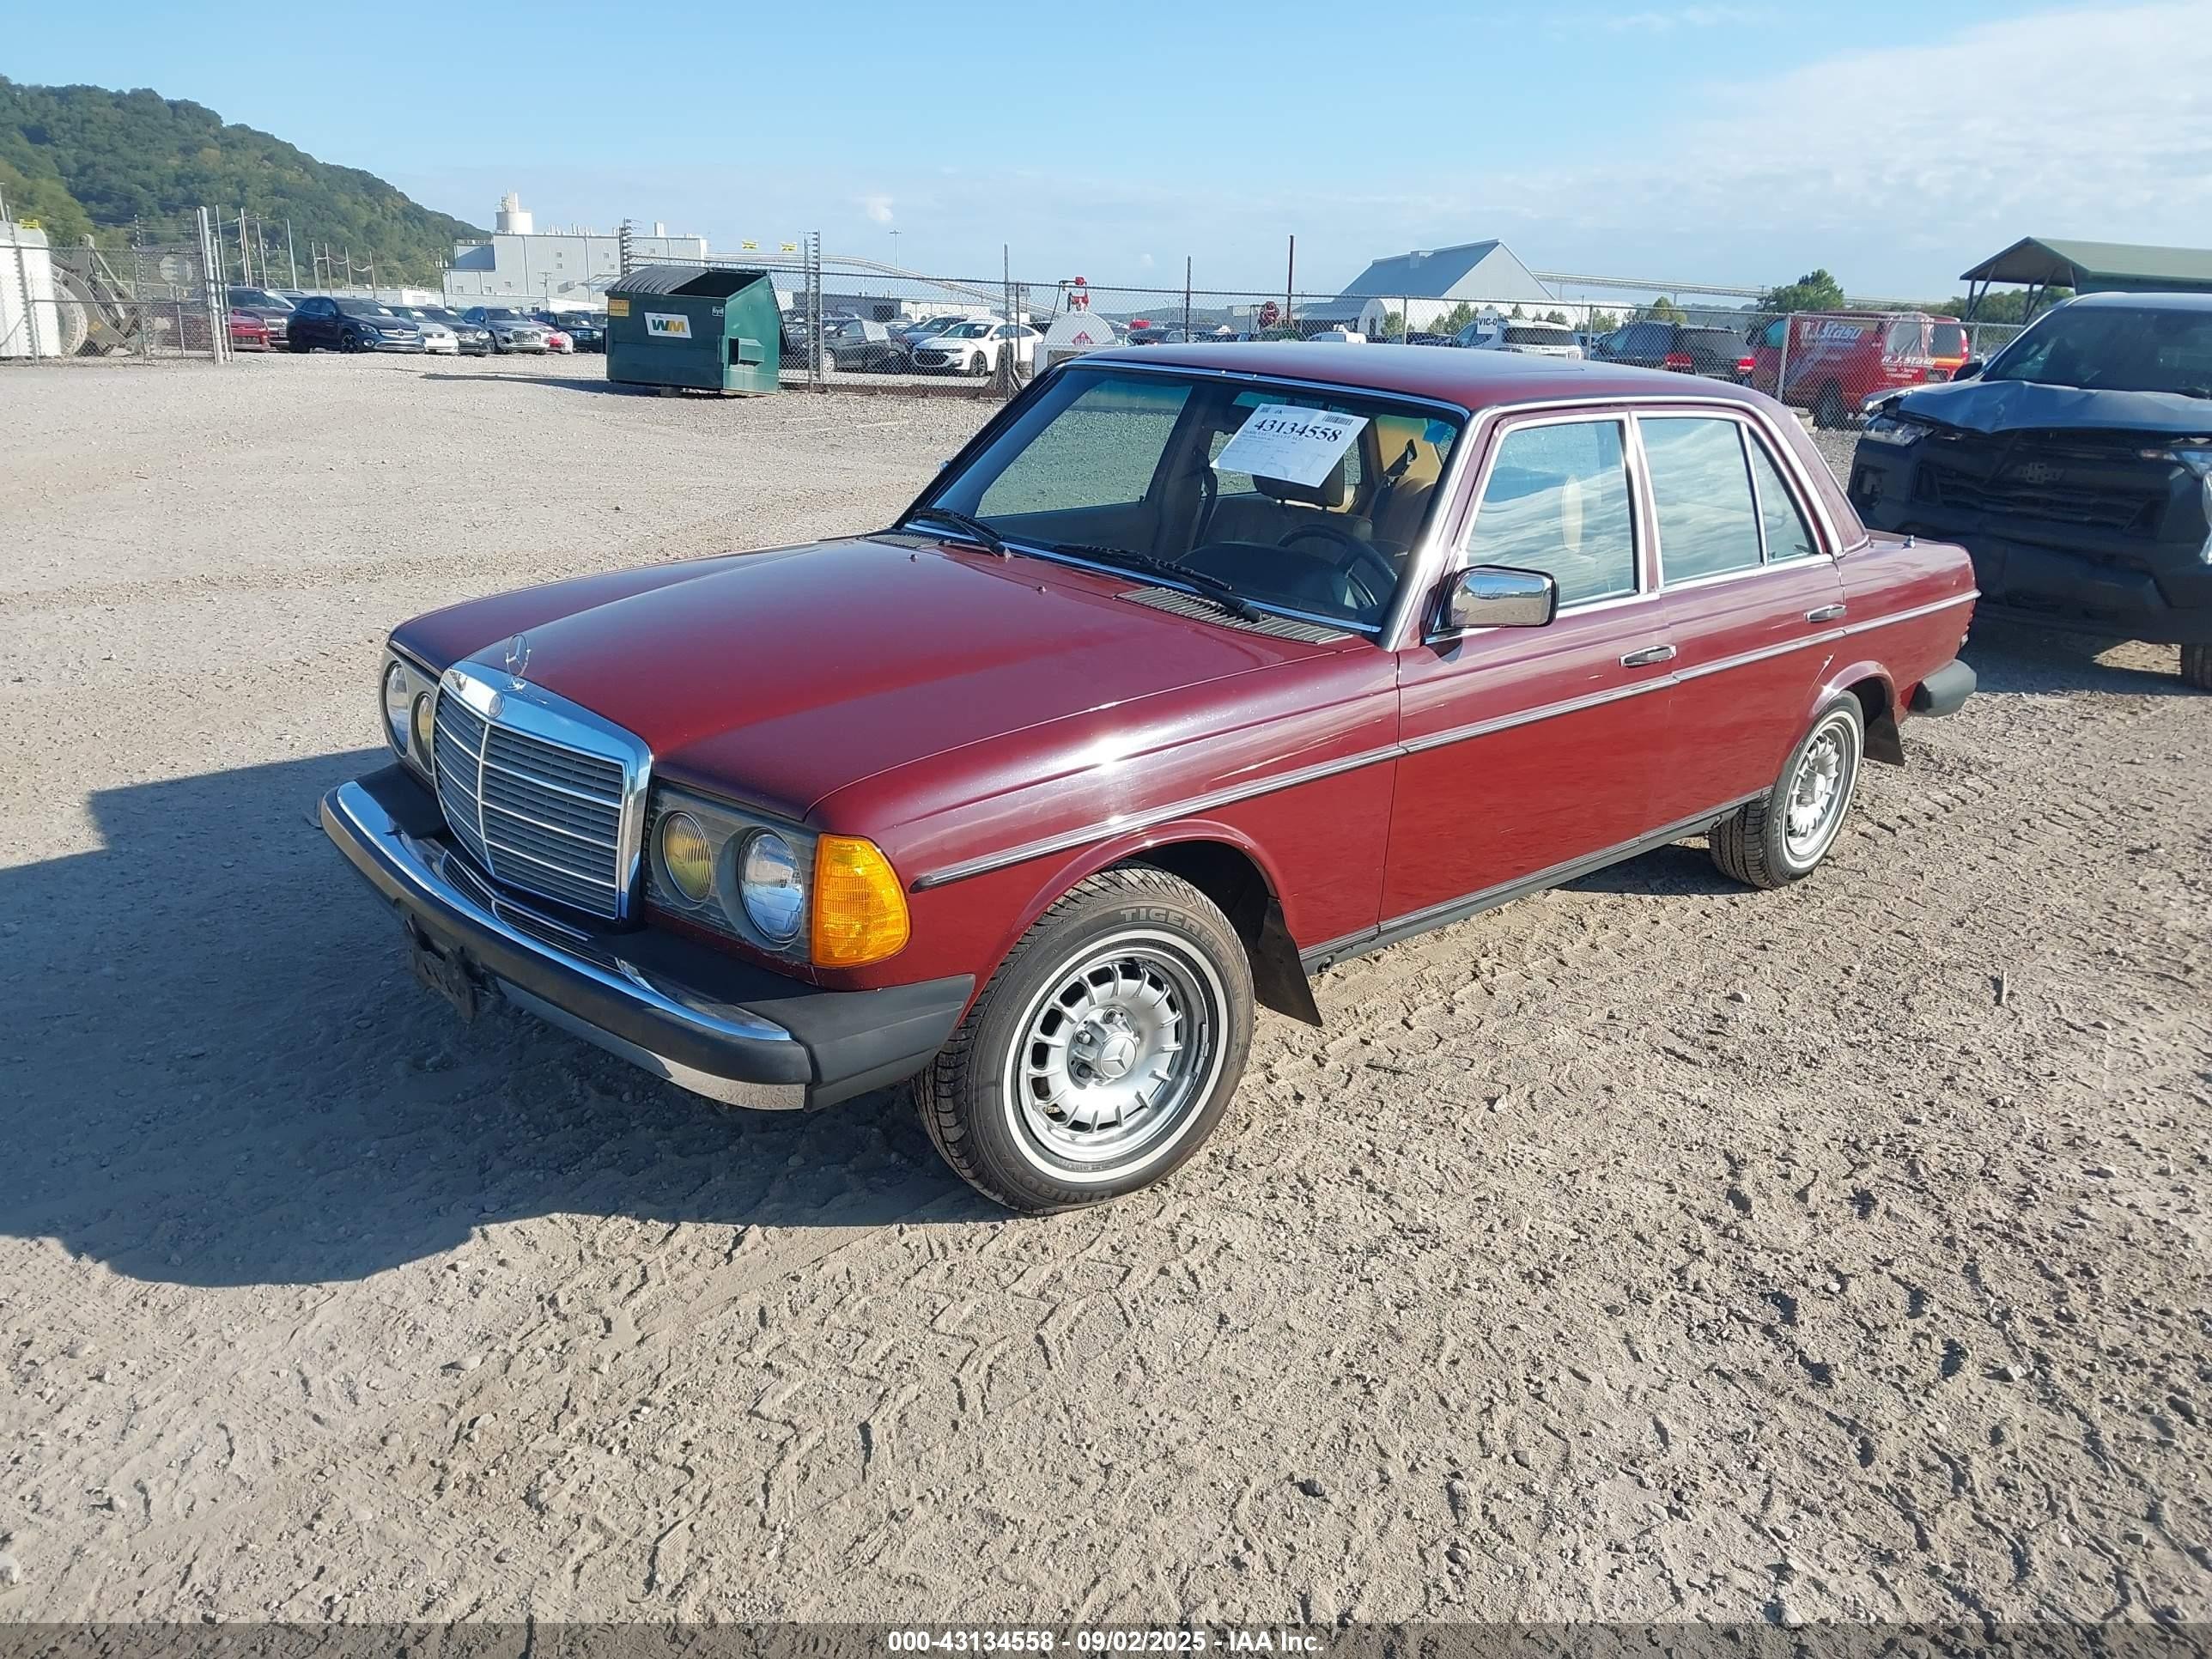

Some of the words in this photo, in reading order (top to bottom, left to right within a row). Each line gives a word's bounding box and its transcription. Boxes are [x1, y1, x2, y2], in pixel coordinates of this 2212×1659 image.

[651, 319, 686, 333] WM
[1254, 418, 1342, 442] 43134558
[1120, 908, 1201, 934] TIGER
